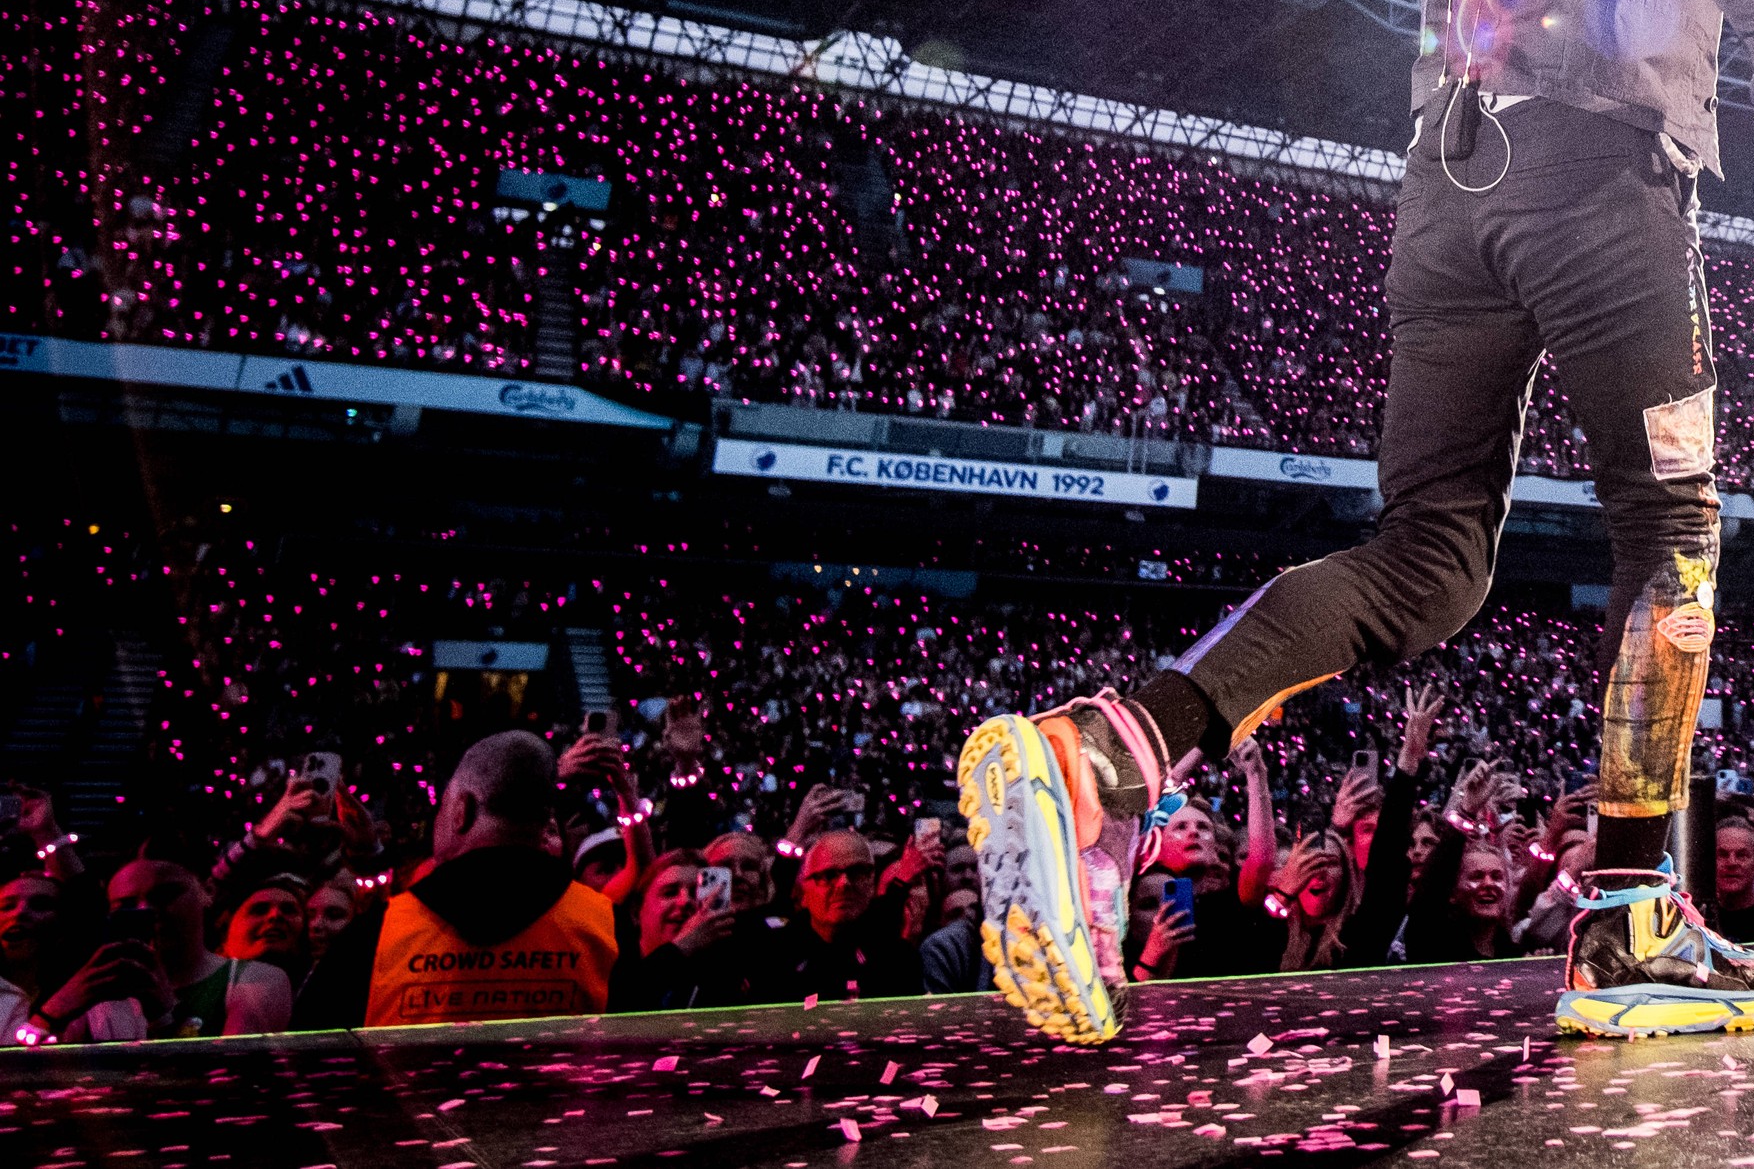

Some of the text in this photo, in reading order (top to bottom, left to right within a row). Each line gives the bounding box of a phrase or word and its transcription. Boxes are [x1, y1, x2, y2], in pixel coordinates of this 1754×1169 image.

[826, 454, 1105, 496] F.C. KØBENHAVN 1992
[408, 950, 581, 973] CROWD SAFETY
